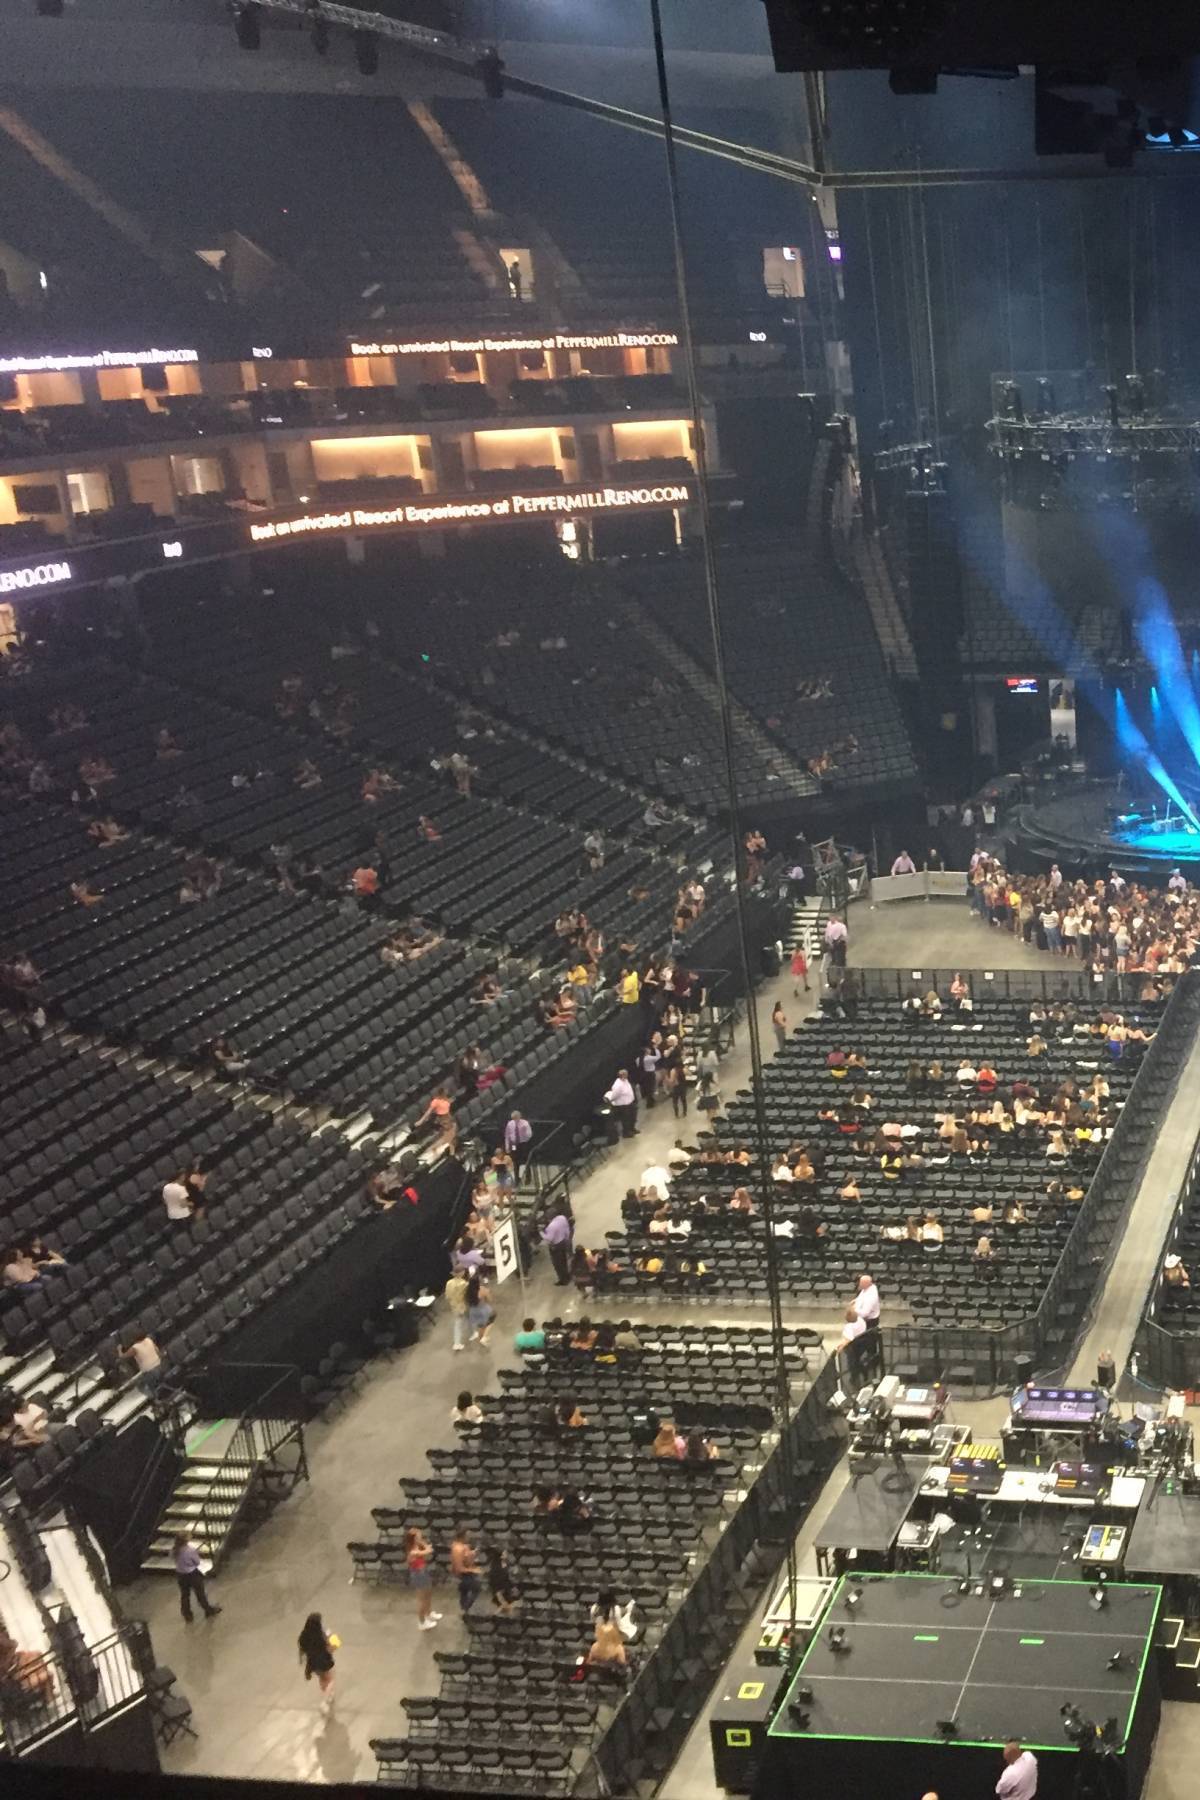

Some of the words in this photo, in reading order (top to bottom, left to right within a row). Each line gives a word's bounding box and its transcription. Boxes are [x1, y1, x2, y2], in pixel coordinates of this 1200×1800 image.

[351, 341, 380, 354] Book
[484, 337, 542, 351] Experience
[543, 338, 555, 348] at
[353, 508, 403, 526] Resort
[405, 502, 491, 523] Experience
[493, 499, 510, 515] at
[511, 486, 689, 513] PEPPERMILLRENO.COM
[499, 1233, 512, 1267] 5
